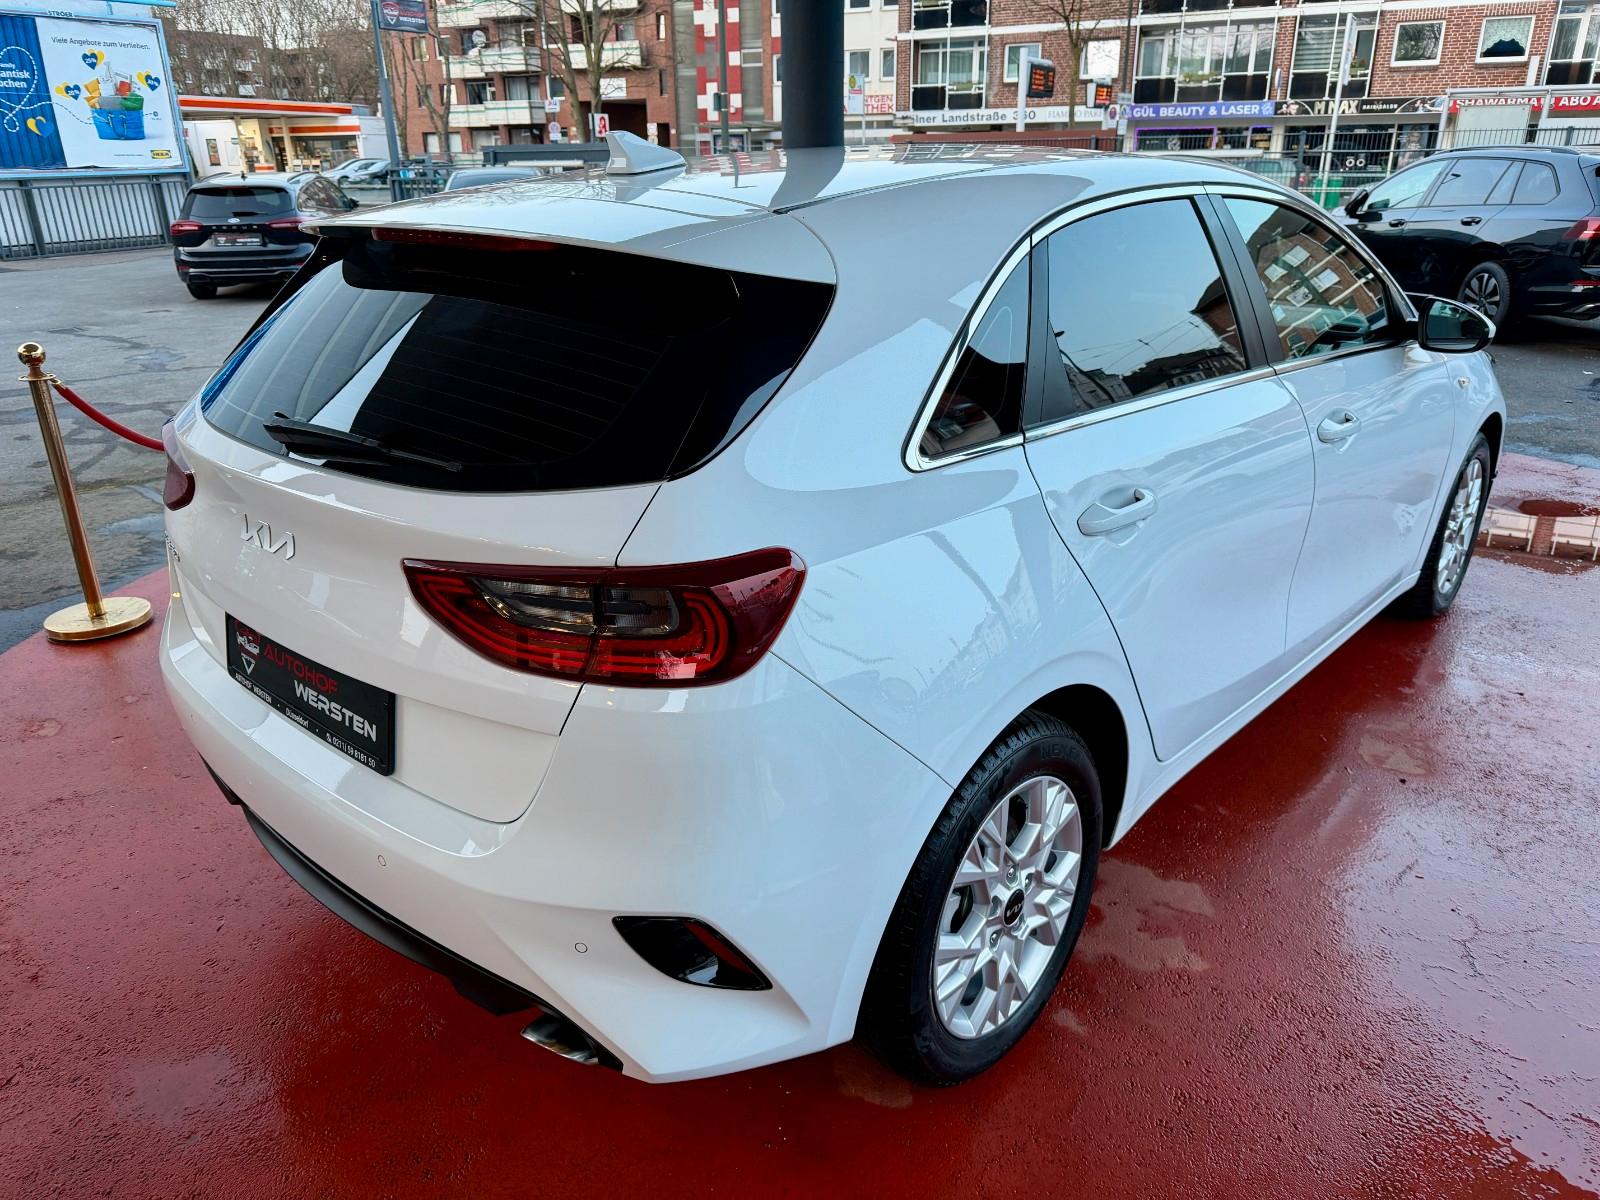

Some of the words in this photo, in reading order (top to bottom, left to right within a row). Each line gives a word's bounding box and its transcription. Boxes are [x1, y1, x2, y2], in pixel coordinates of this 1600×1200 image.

[51, 36, 68, 44] Viele
[69, 37, 102, 47] Angebote
[118, 40, 151, 50] Verlieben.
[1560, 95, 1592, 107] ABO
[941, 110, 1007, 123] Landstraße
[1133, 105, 1156, 117] GÜL
[1160, 105, 1205, 117] BEAUTY
[1208, 105, 1218, 116] &
[1221, 104, 1261, 115] LASER
[240, 513, 296, 561] KIA
[263, 643, 338, 694] AUTOHOF
[294, 679, 377, 742] WERSTEN
